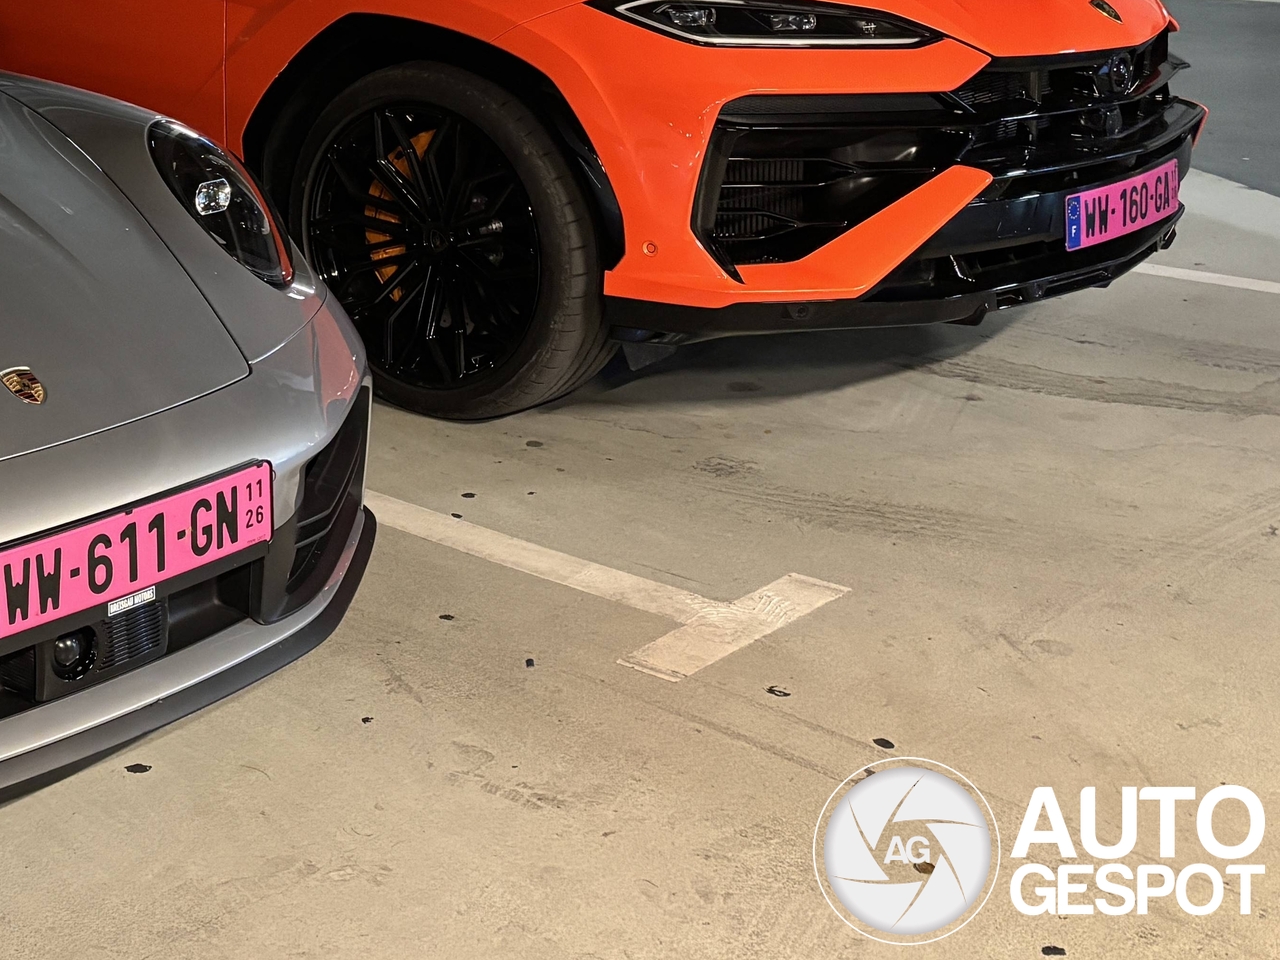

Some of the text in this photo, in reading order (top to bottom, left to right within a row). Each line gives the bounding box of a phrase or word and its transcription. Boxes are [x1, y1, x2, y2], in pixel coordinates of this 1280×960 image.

[1071, 225, 1077, 238] F
[245, 478, 262, 502] 11
[245, 505, 264, 529] 26
[3, 485, 239, 625] WW-611-GN
